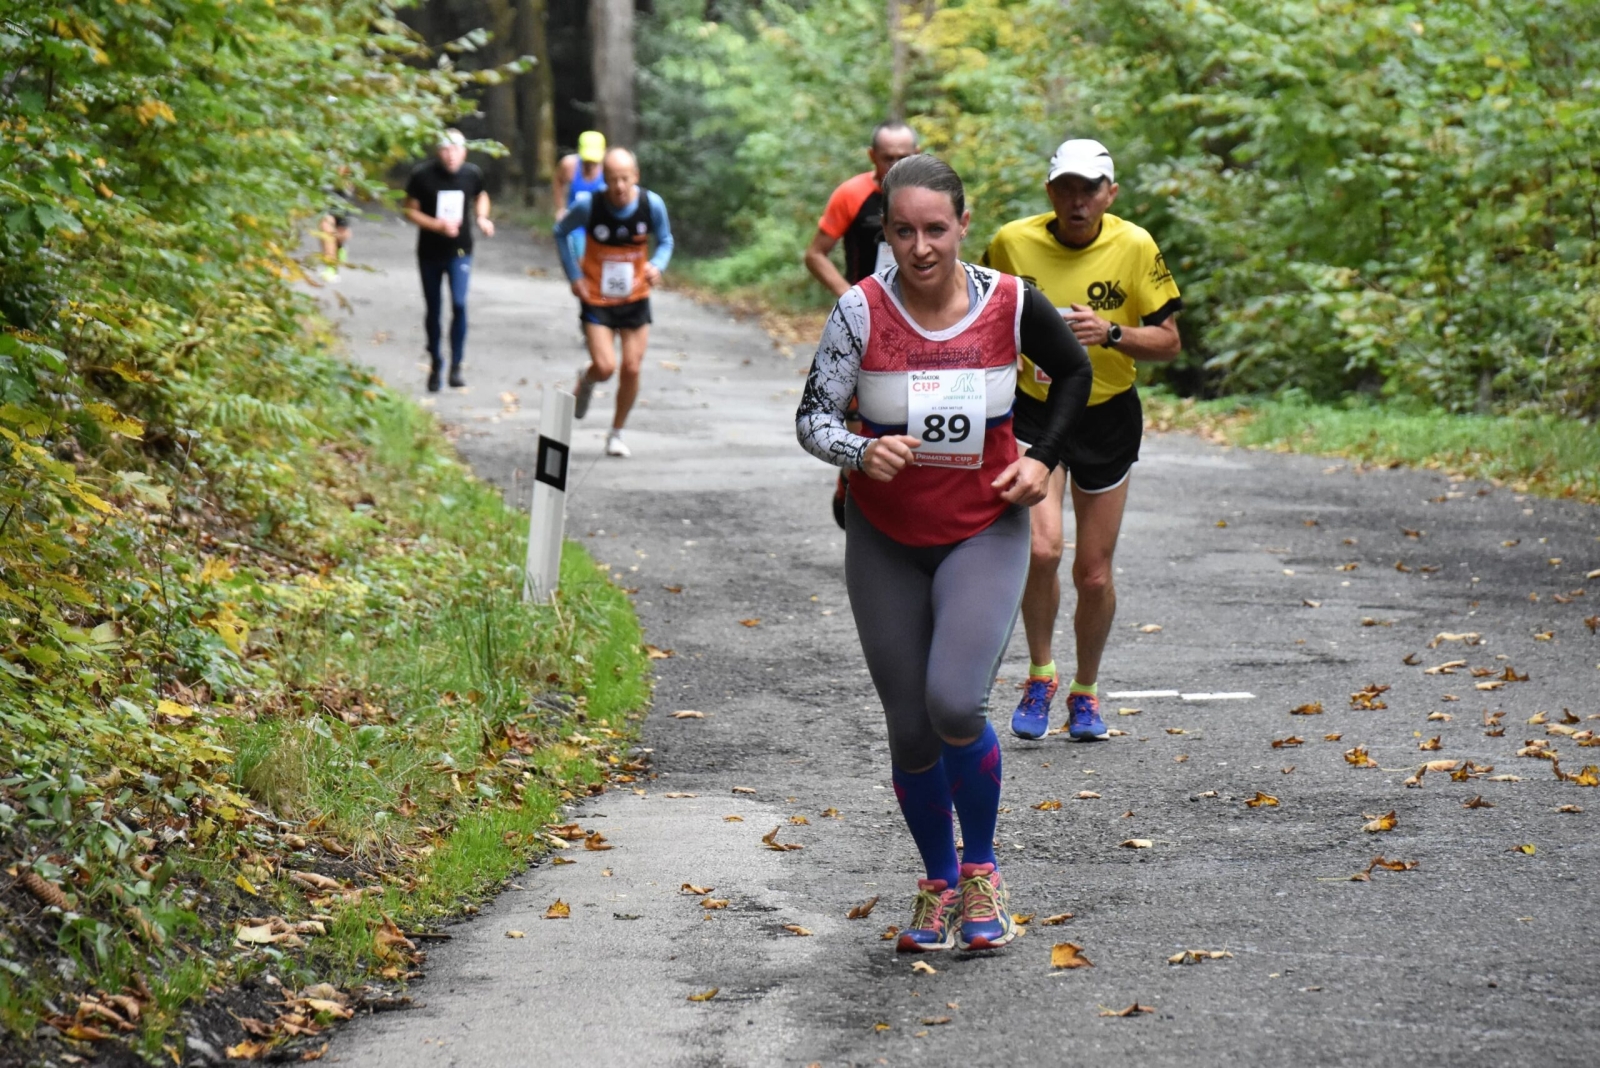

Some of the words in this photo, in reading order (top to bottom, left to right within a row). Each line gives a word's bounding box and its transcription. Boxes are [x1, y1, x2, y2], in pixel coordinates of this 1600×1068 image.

[1087, 279, 1127, 301] OK
[912, 382, 940, 392] CUP
[922, 414, 971, 443] 89
[916, 453, 952, 461] PRIMATOR
